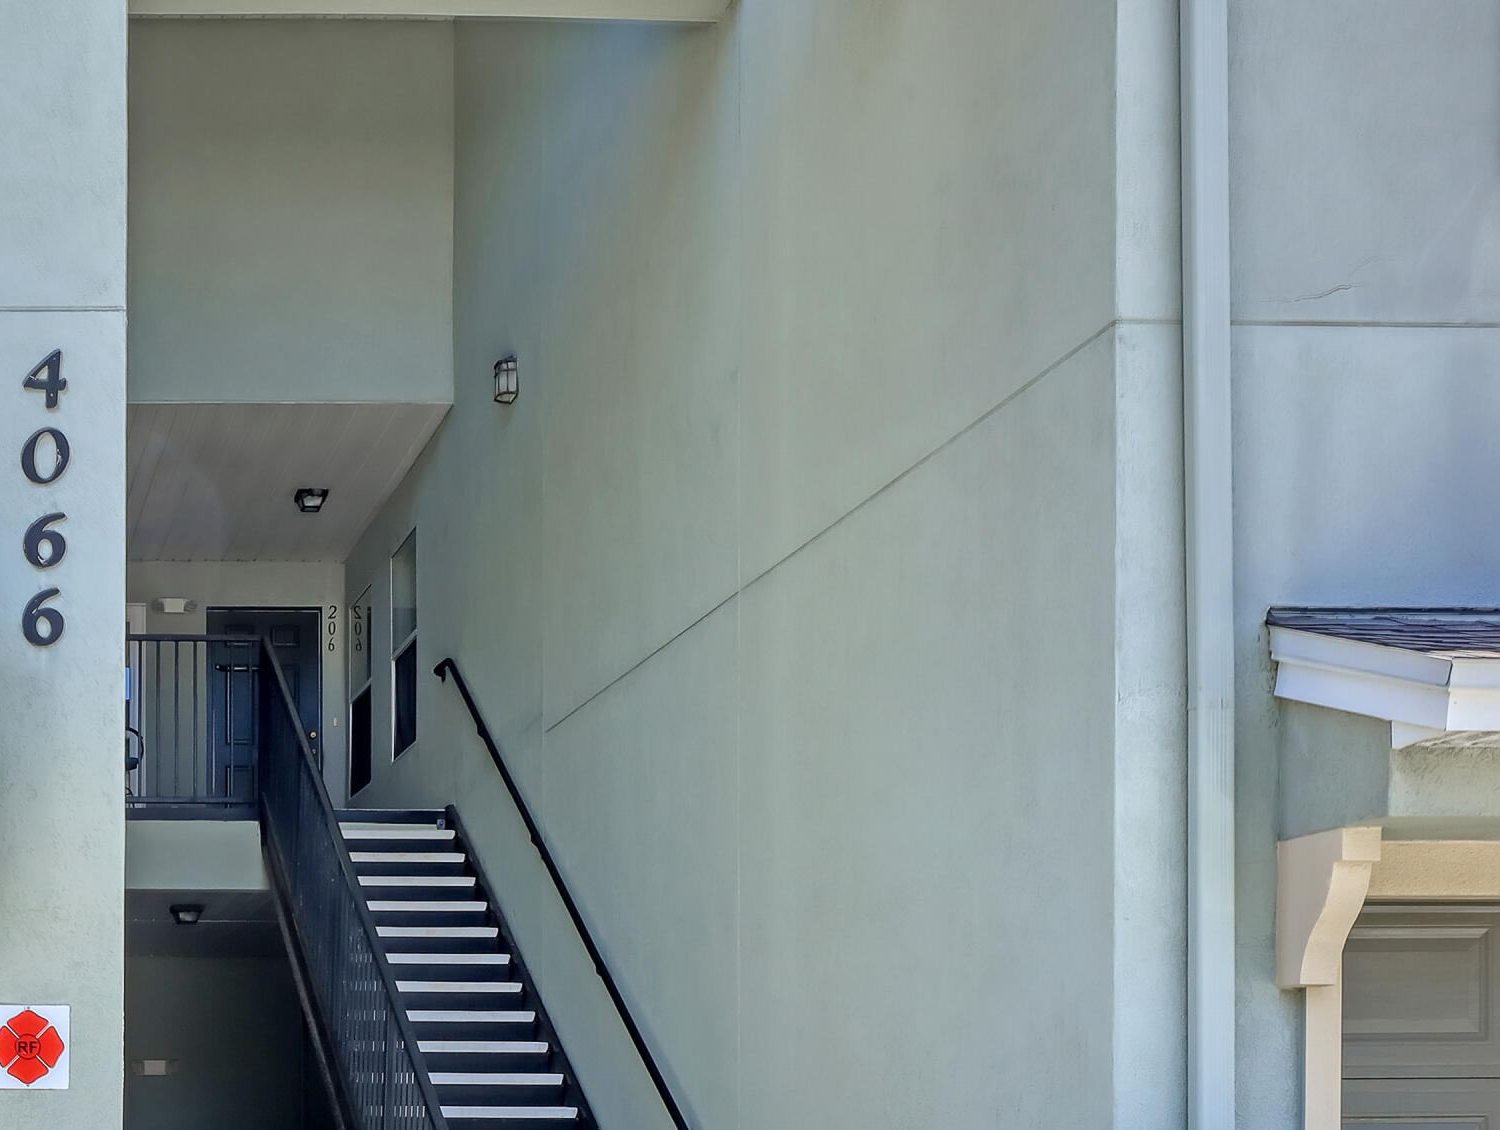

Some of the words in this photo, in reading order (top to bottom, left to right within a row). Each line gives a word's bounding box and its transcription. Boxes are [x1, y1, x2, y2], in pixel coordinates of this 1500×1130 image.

[20, 347, 71, 648] 4066
[328, 604, 337, 651] 206
[17, 1040, 38, 1054] RF
